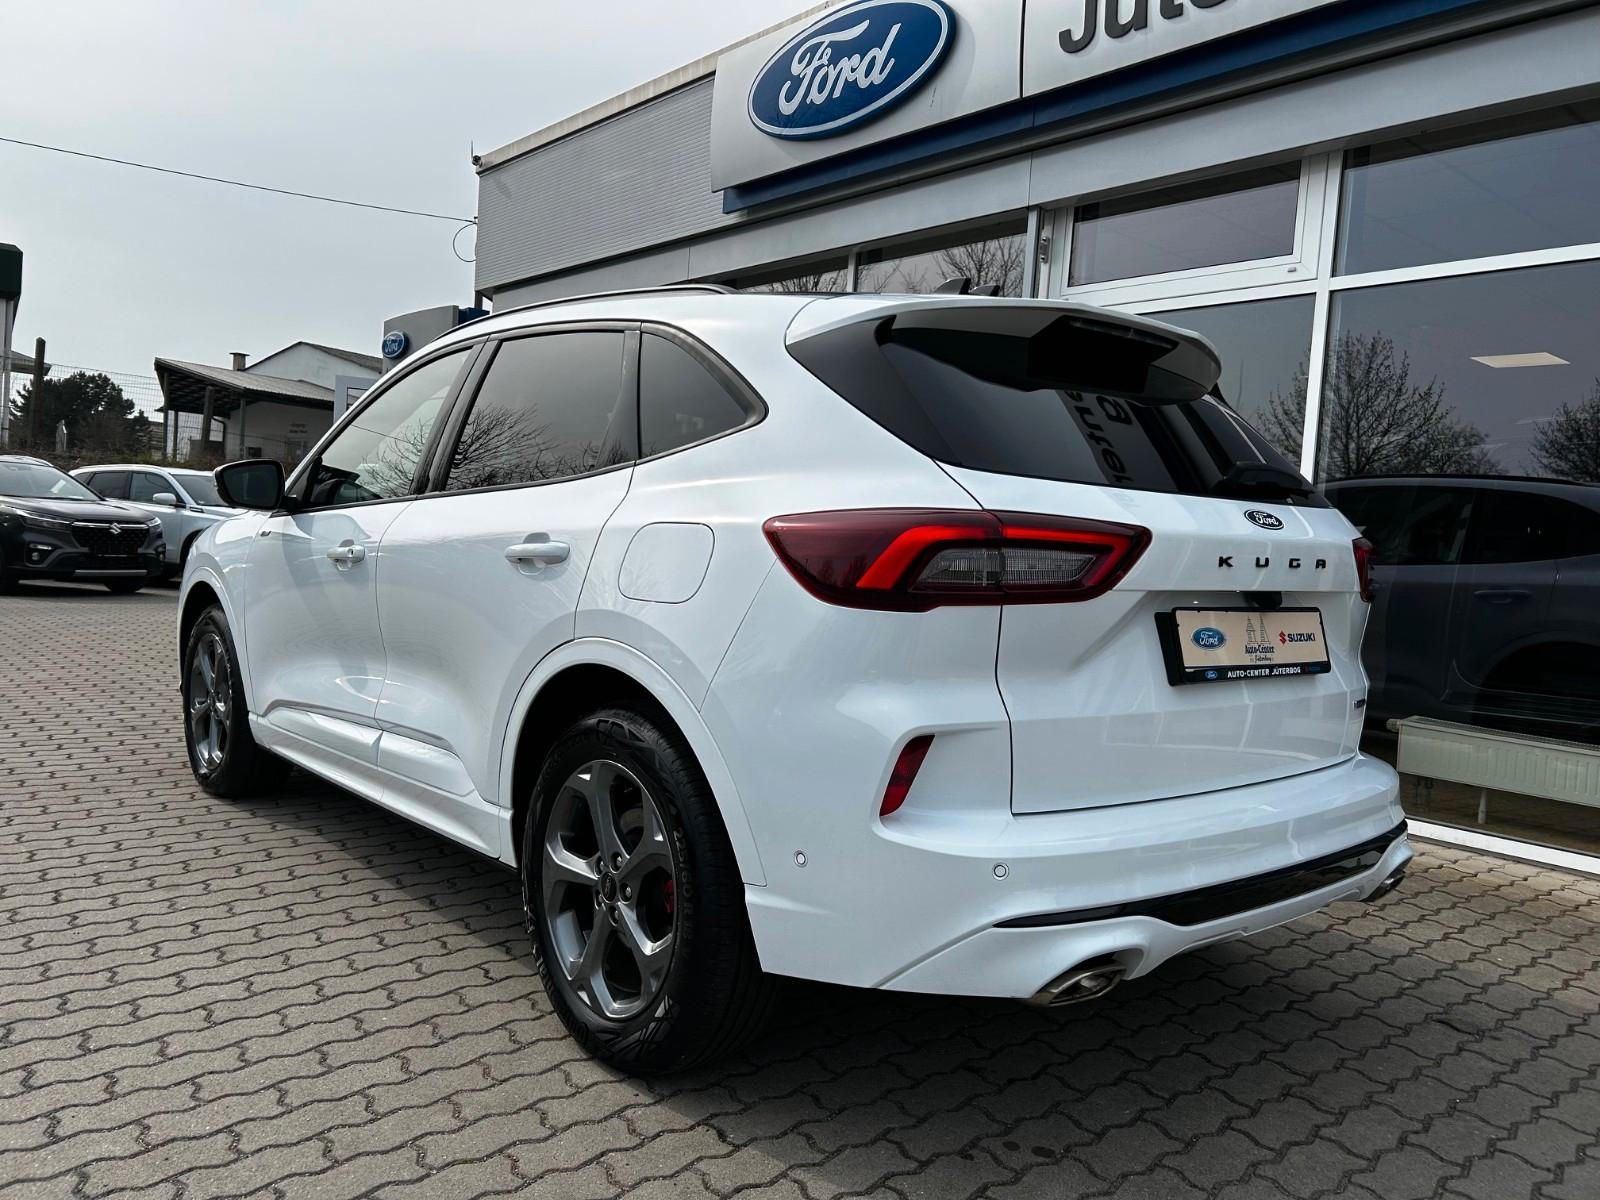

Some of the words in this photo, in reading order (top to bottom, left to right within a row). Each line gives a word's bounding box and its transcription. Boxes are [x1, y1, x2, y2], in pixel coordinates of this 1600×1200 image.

[778, 19, 901, 116] Ford
[1253, 511, 1279, 526] Ford
[1218, 556, 1327, 569] KUGA
[1199, 630, 1219, 645] Ford
[1287, 632, 1316, 643] SUZUKI
[1227, 668, 1270, 678] AUTO-CENTER
[1271, 666, 1301, 675] JÜTERBOG
